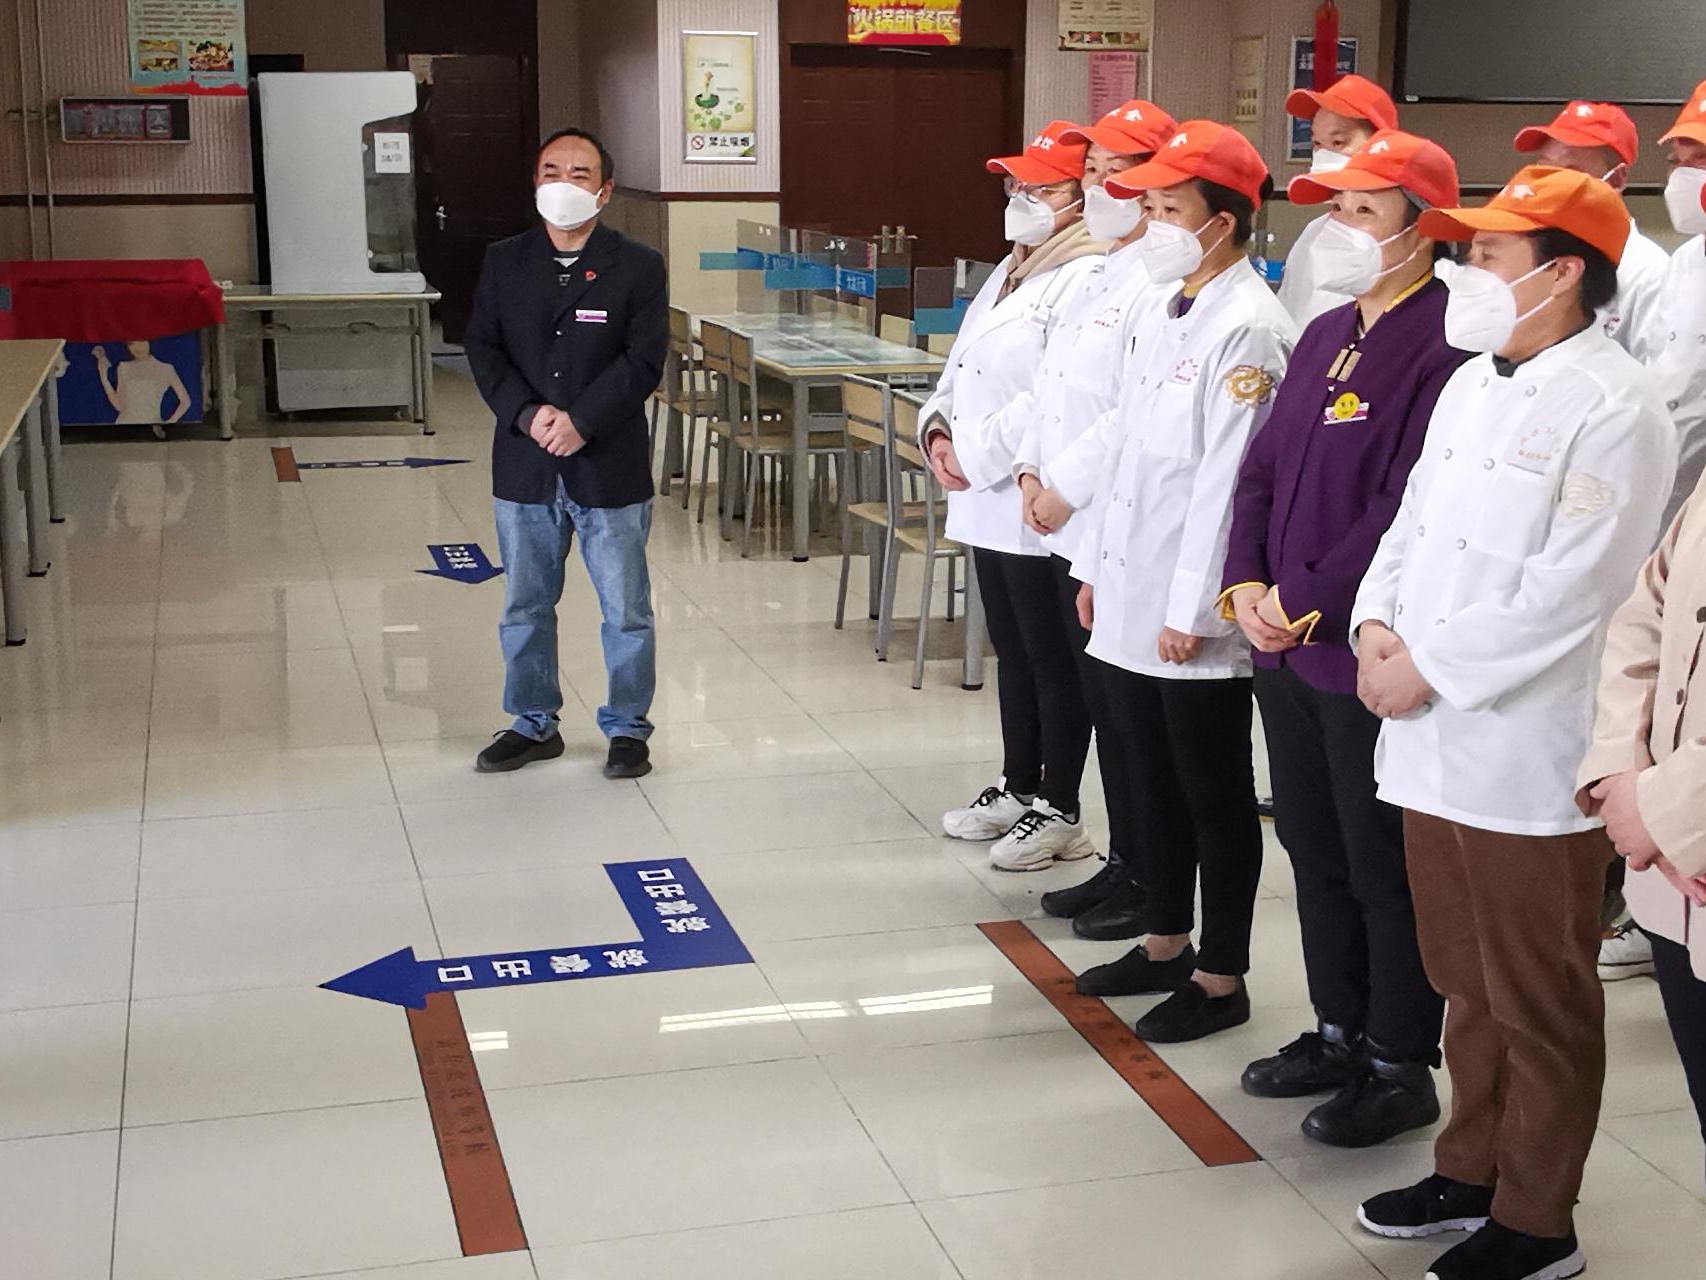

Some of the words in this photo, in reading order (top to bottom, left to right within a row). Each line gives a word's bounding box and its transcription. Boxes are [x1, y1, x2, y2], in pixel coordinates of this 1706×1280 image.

[850, 7, 956, 34] 火锅就餐区
[637, 867, 712, 934] 就餐出口
[437, 948, 649, 984] 就餐出口
